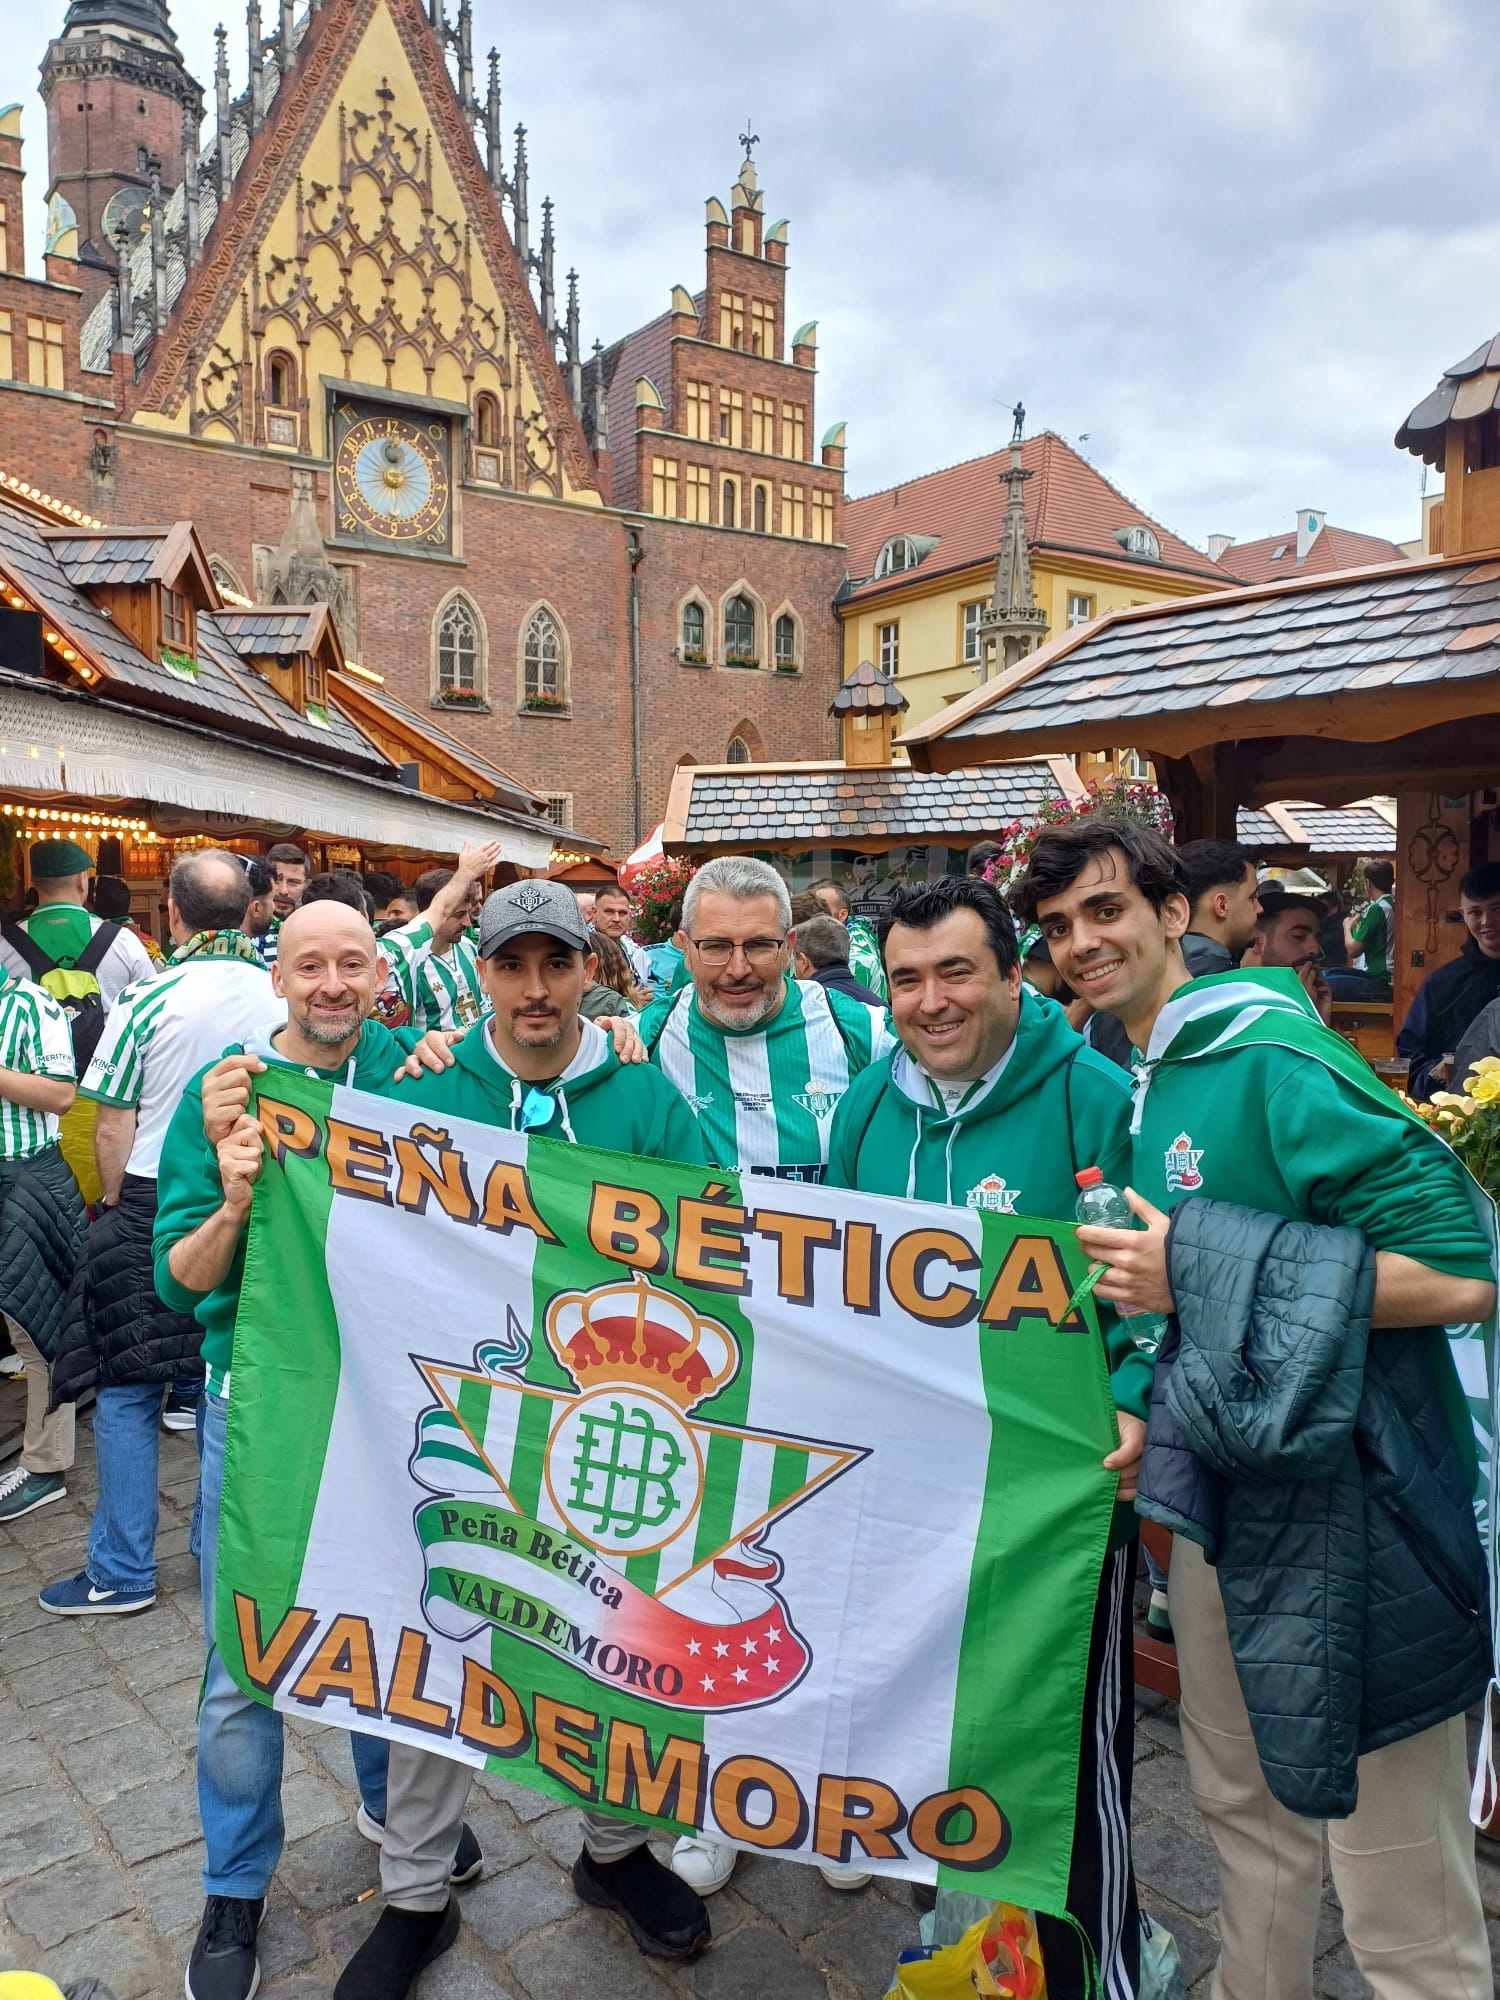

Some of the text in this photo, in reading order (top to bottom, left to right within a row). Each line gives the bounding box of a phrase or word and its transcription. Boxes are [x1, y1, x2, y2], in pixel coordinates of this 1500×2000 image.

[343, 436, 359, 451] 10
[363, 421, 375, 437] 11
[387, 420, 399, 434] 12
[90, 1056, 116, 1074] KING
[256, 1093, 1089, 1333] PEÑA BÉTICA
[439, 1508, 624, 1611] Peña Bética
[445, 1573, 683, 1697] VALDEMORO
[234, 1589, 1012, 1872] VALDEMORO
